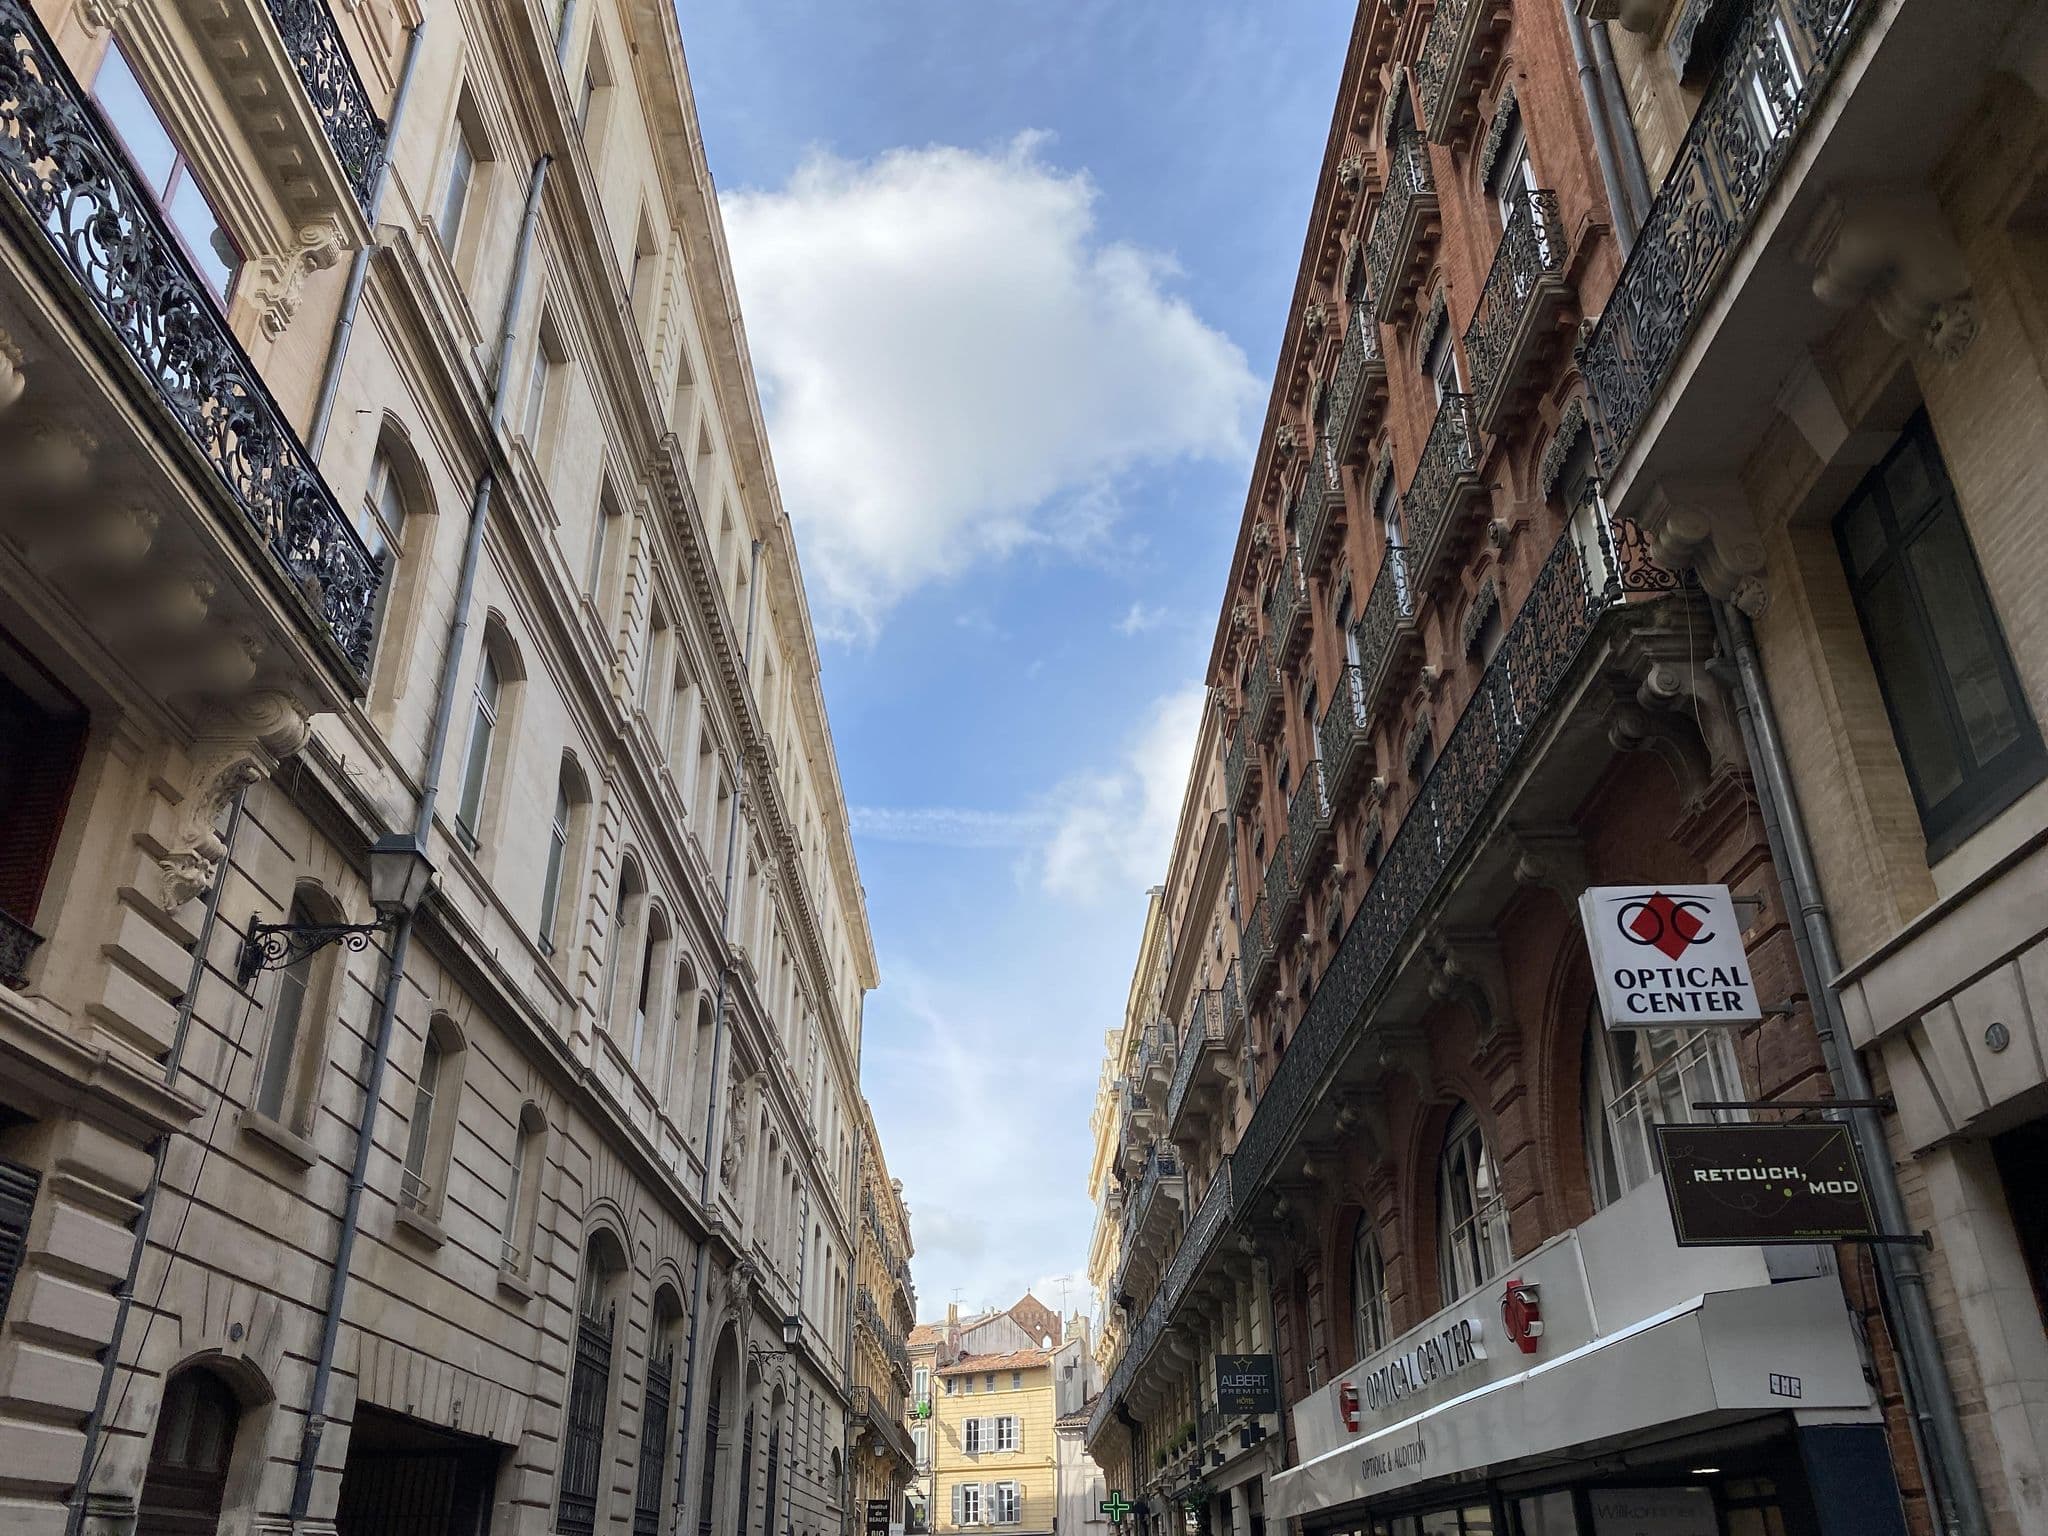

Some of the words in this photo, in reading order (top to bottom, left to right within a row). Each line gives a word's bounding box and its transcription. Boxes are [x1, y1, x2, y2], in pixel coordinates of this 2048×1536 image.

[1613, 966, 1749, 990] OPTICAL
[1626, 991, 1744, 1014] CENTER
[1693, 1166, 1808, 1183] RETOUCH,
[1808, 1180, 1859, 1195] MOD
[1366, 1353, 1418, 1411] OPTICAL
[1417, 1318, 1479, 1385] CENTER
[1220, 1374, 1268, 1387] ALBERT
[1361, 1453, 1387, 1480] OPTIQUE
[1394, 1439, 1427, 1469] AUDITION
